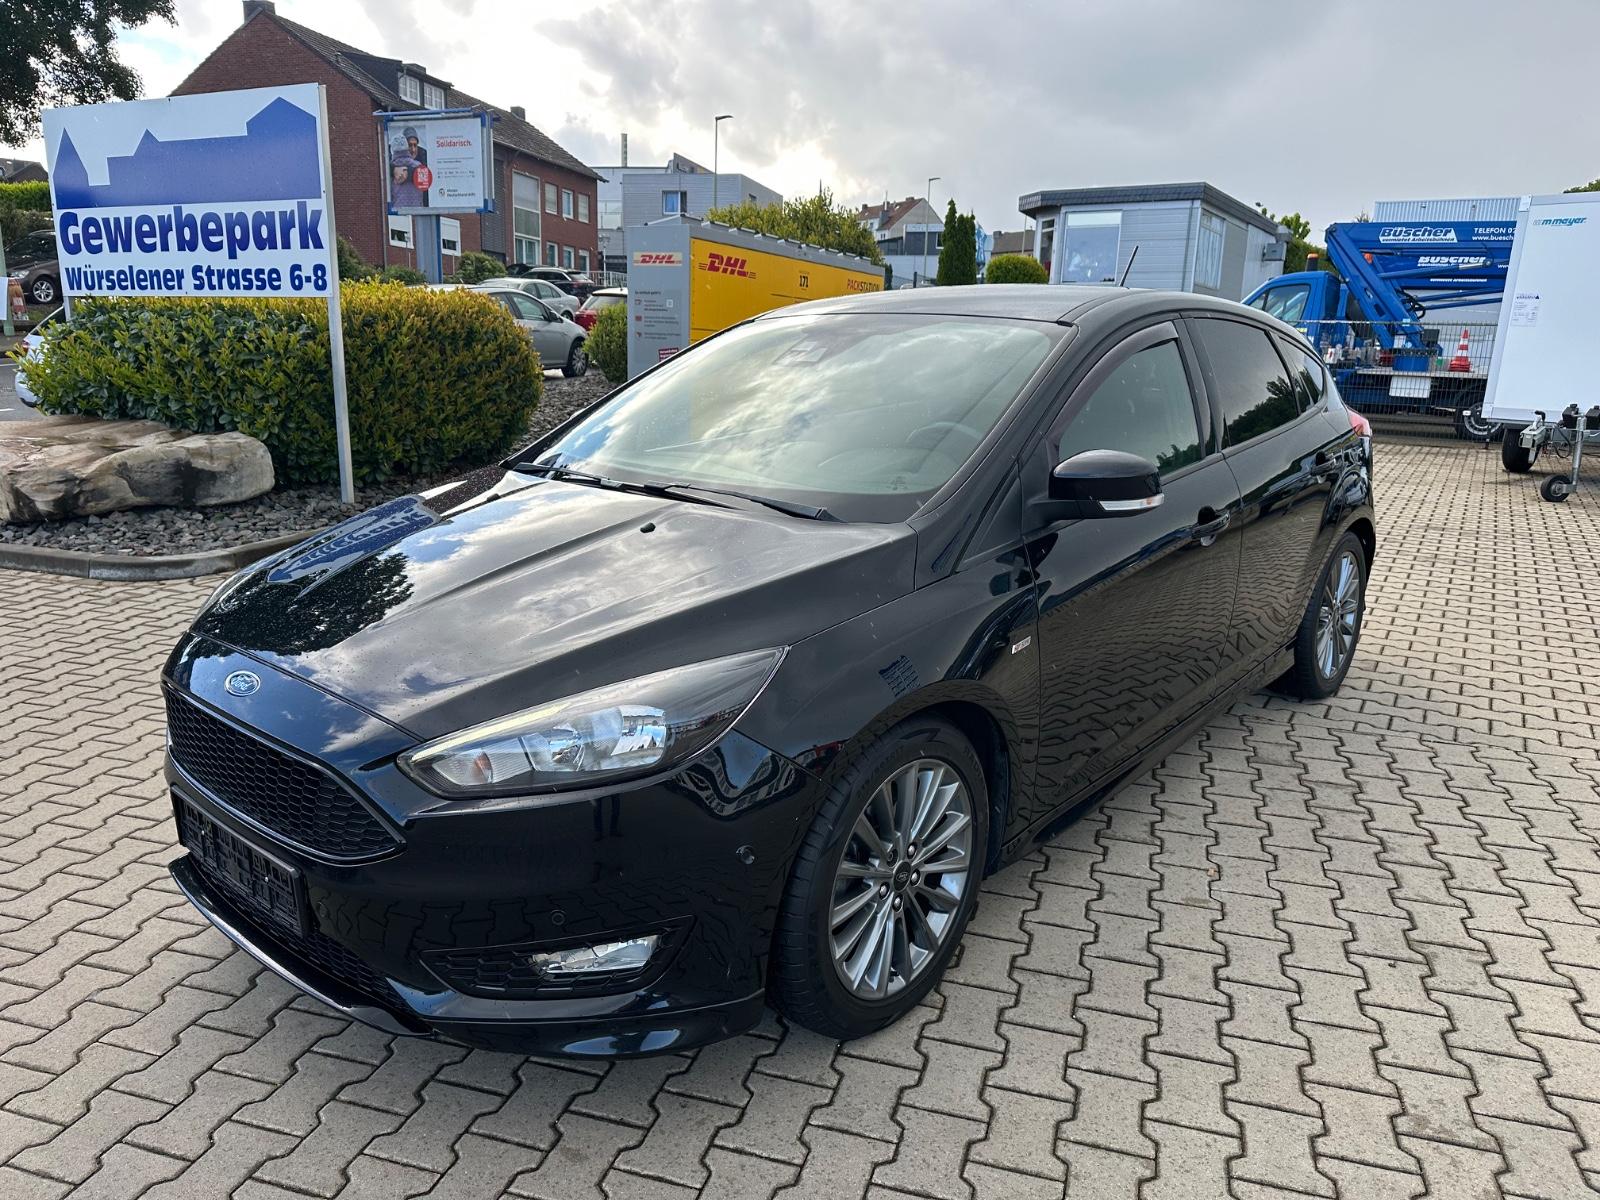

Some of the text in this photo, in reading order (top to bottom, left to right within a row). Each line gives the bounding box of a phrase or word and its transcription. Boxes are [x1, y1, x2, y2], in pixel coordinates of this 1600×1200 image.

[58, 201, 325, 259] Gewerbepark
[1380, 226, 1452, 237] Büscher
[640, 254, 676, 264] DHL
[707, 252, 749, 278] DHL
[65, 263, 328, 292] Würselener Strasse 6-8
[846, 278, 880, 293] PACKSTATION
